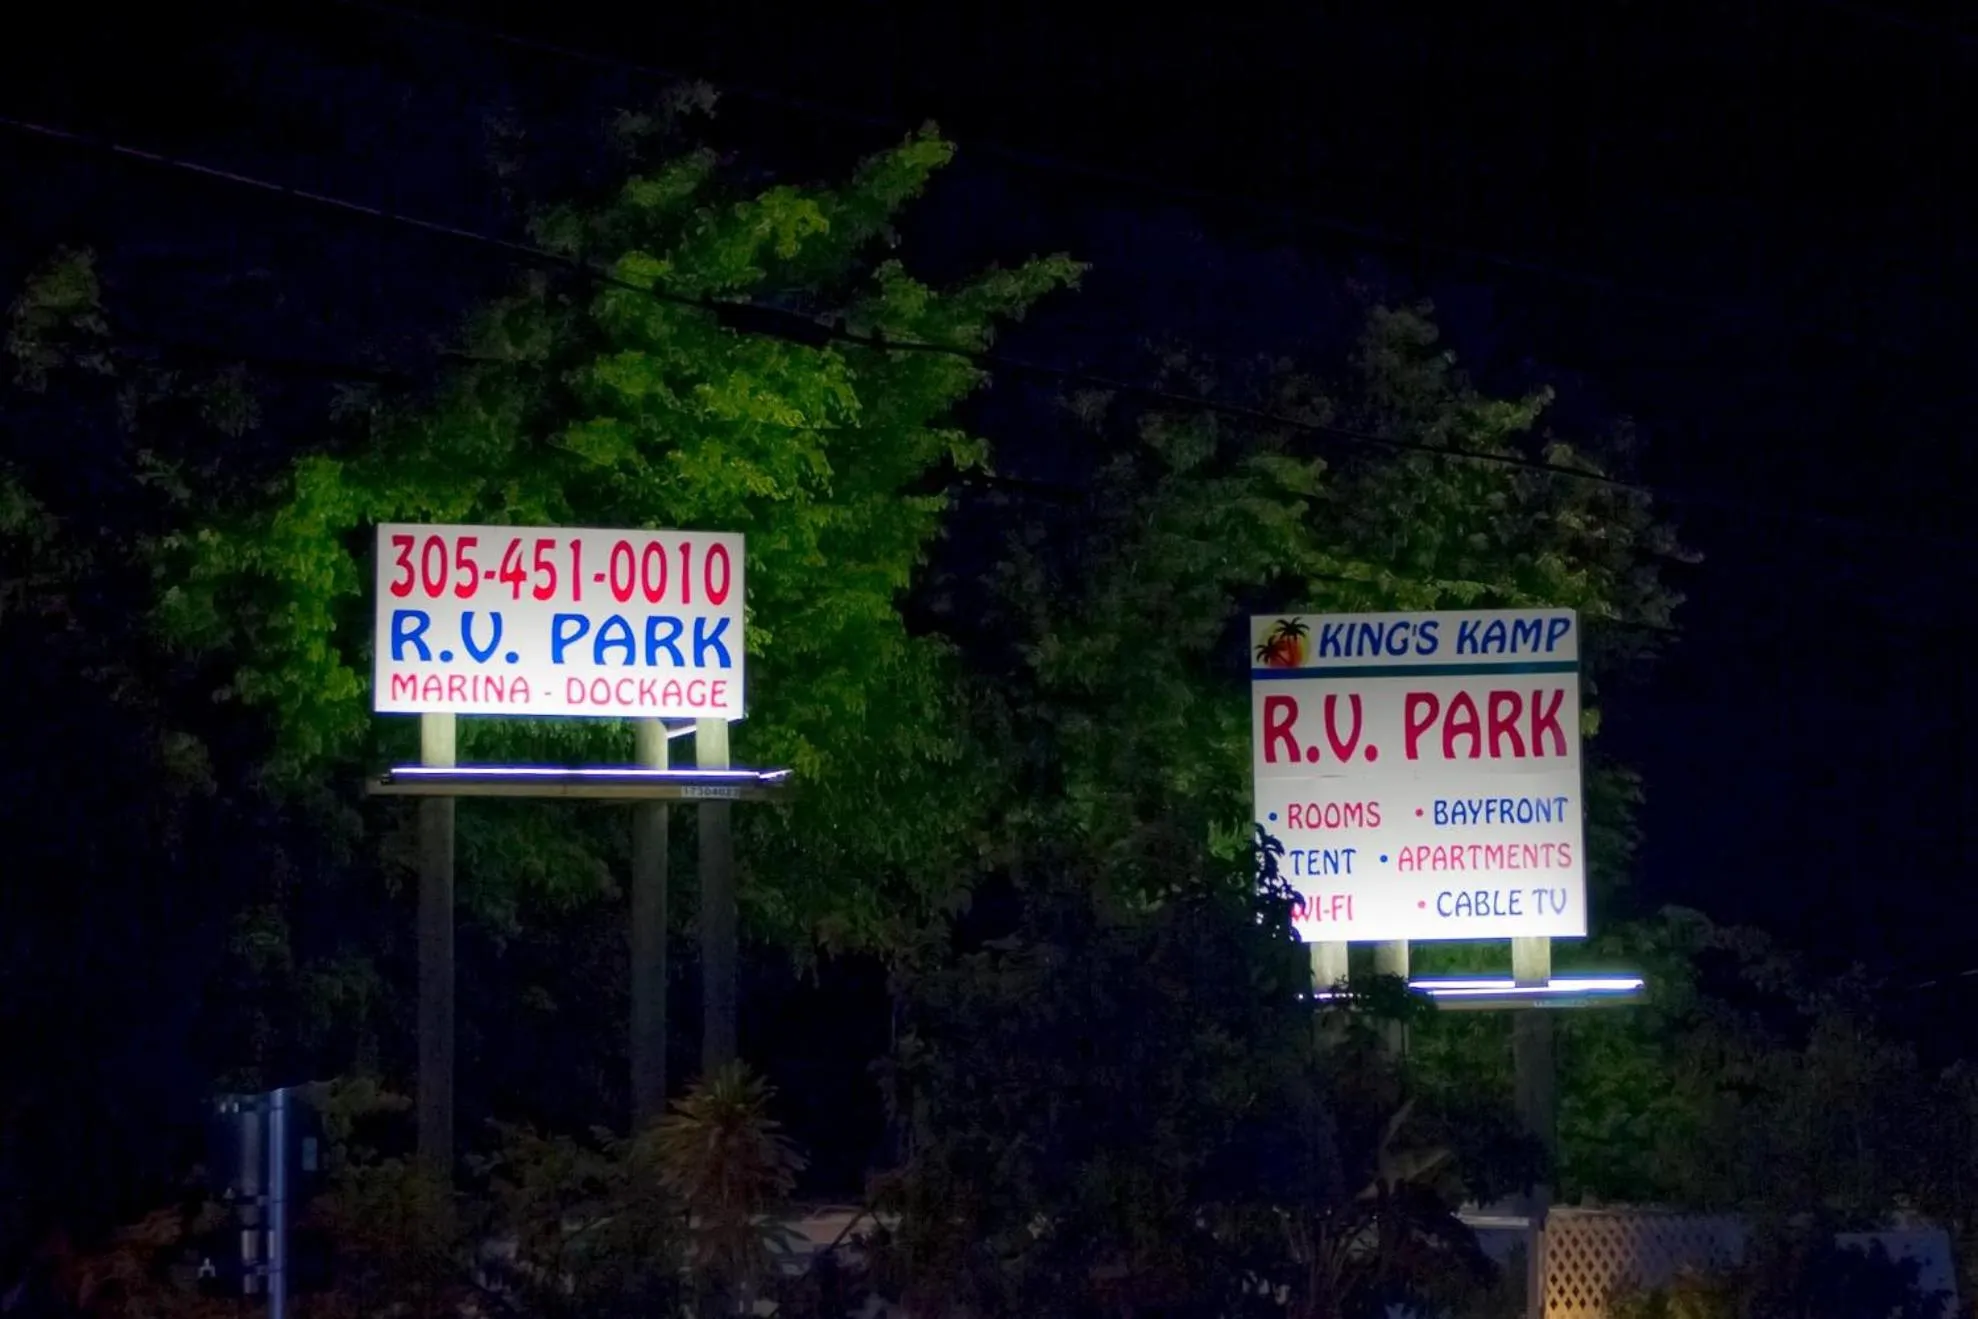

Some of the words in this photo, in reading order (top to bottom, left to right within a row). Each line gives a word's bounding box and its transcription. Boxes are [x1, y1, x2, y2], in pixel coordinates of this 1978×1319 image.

[390, 534, 731, 605] 305-451-0010
[391, 610, 519, 664] R.V.
[551, 613, 731, 668] PARK
[1319, 621, 1439, 658] KING'S
[1456, 617, 1571, 655] KAMP
[391, 673, 530, 703] MARINA
[567, 677, 727, 707] DOCKAGE
[1263, 693, 1378, 763] R.V.
[1404, 689, 1567, 760] PARK
[1287, 801, 1381, 829] ROOMS
[1434, 797, 1568, 825] BAYFRONT
[1290, 849, 1356, 875] TENT
[1397, 843, 1572, 872] APARTMENTS
[1436, 890, 1523, 917] CABLE
[1532, 888, 1568, 915] TV
